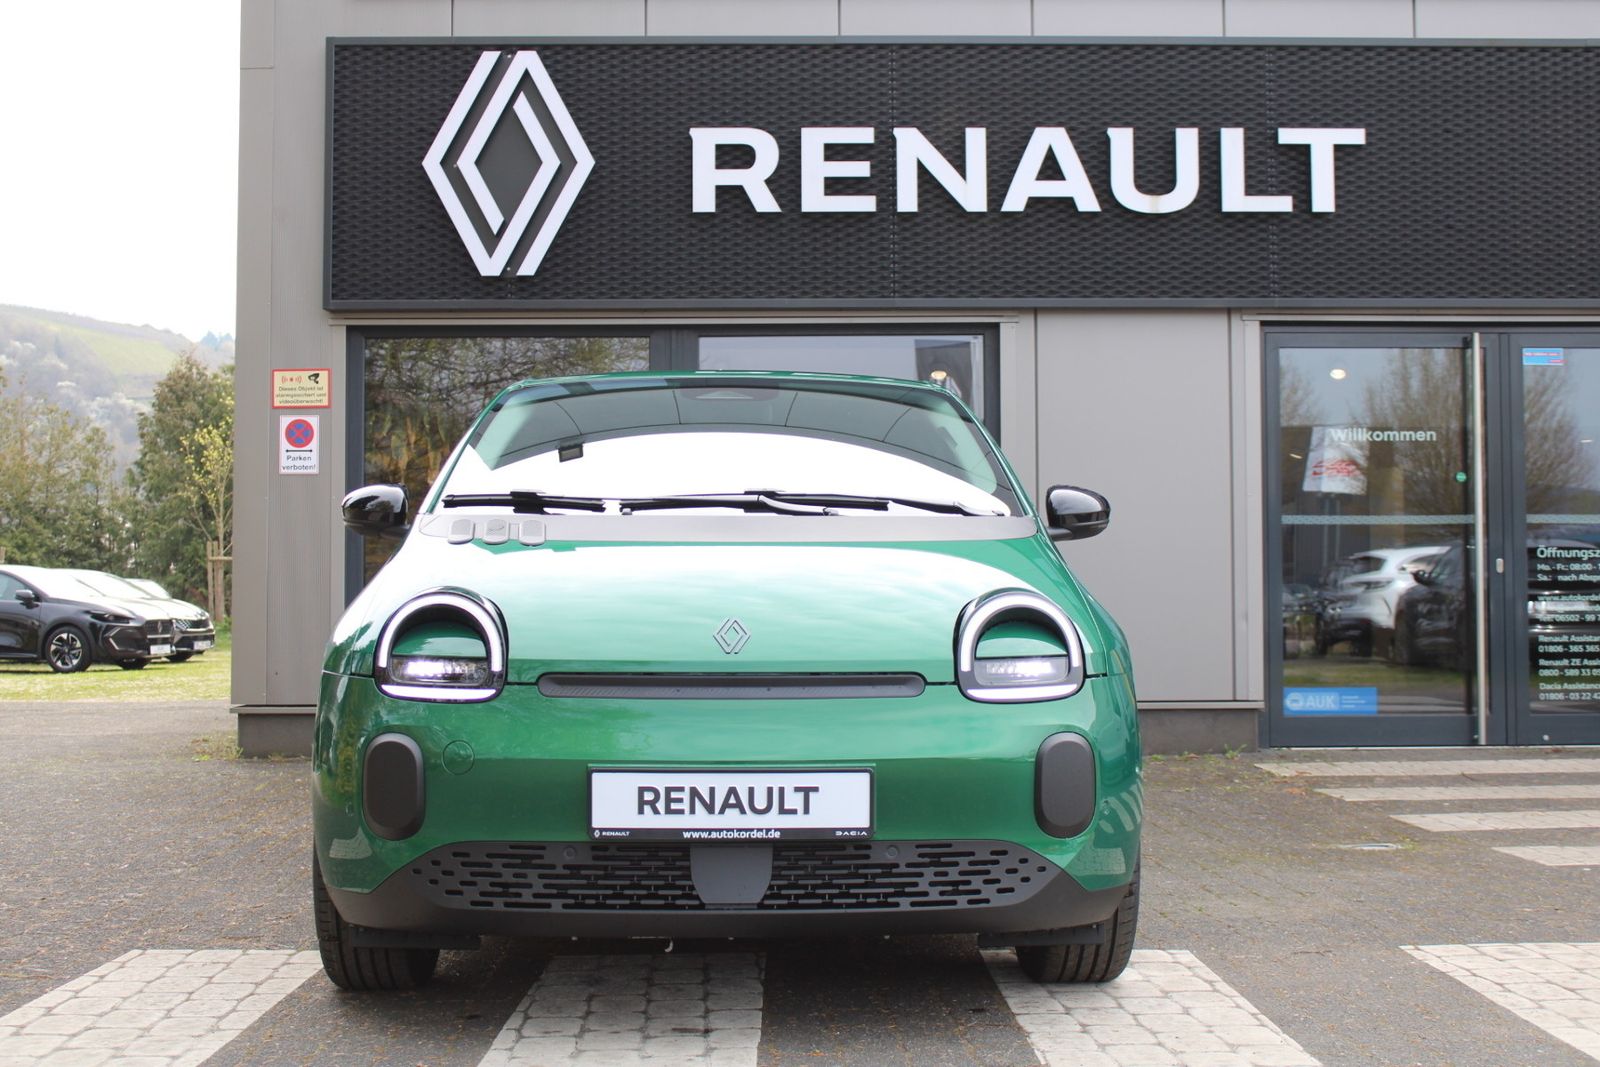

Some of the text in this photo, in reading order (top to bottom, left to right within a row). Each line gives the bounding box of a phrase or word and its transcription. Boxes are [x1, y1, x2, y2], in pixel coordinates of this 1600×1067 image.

[689, 126, 1367, 214] RENAULT
[1328, 427, 1437, 442] Willkommen
[1557, 573, 1578, 581] nach
[1306, 695, 1336, 709] AUK
[637, 785, 820, 816] RENAULT
[682, 829, 781, 840] www.autokordel.de
